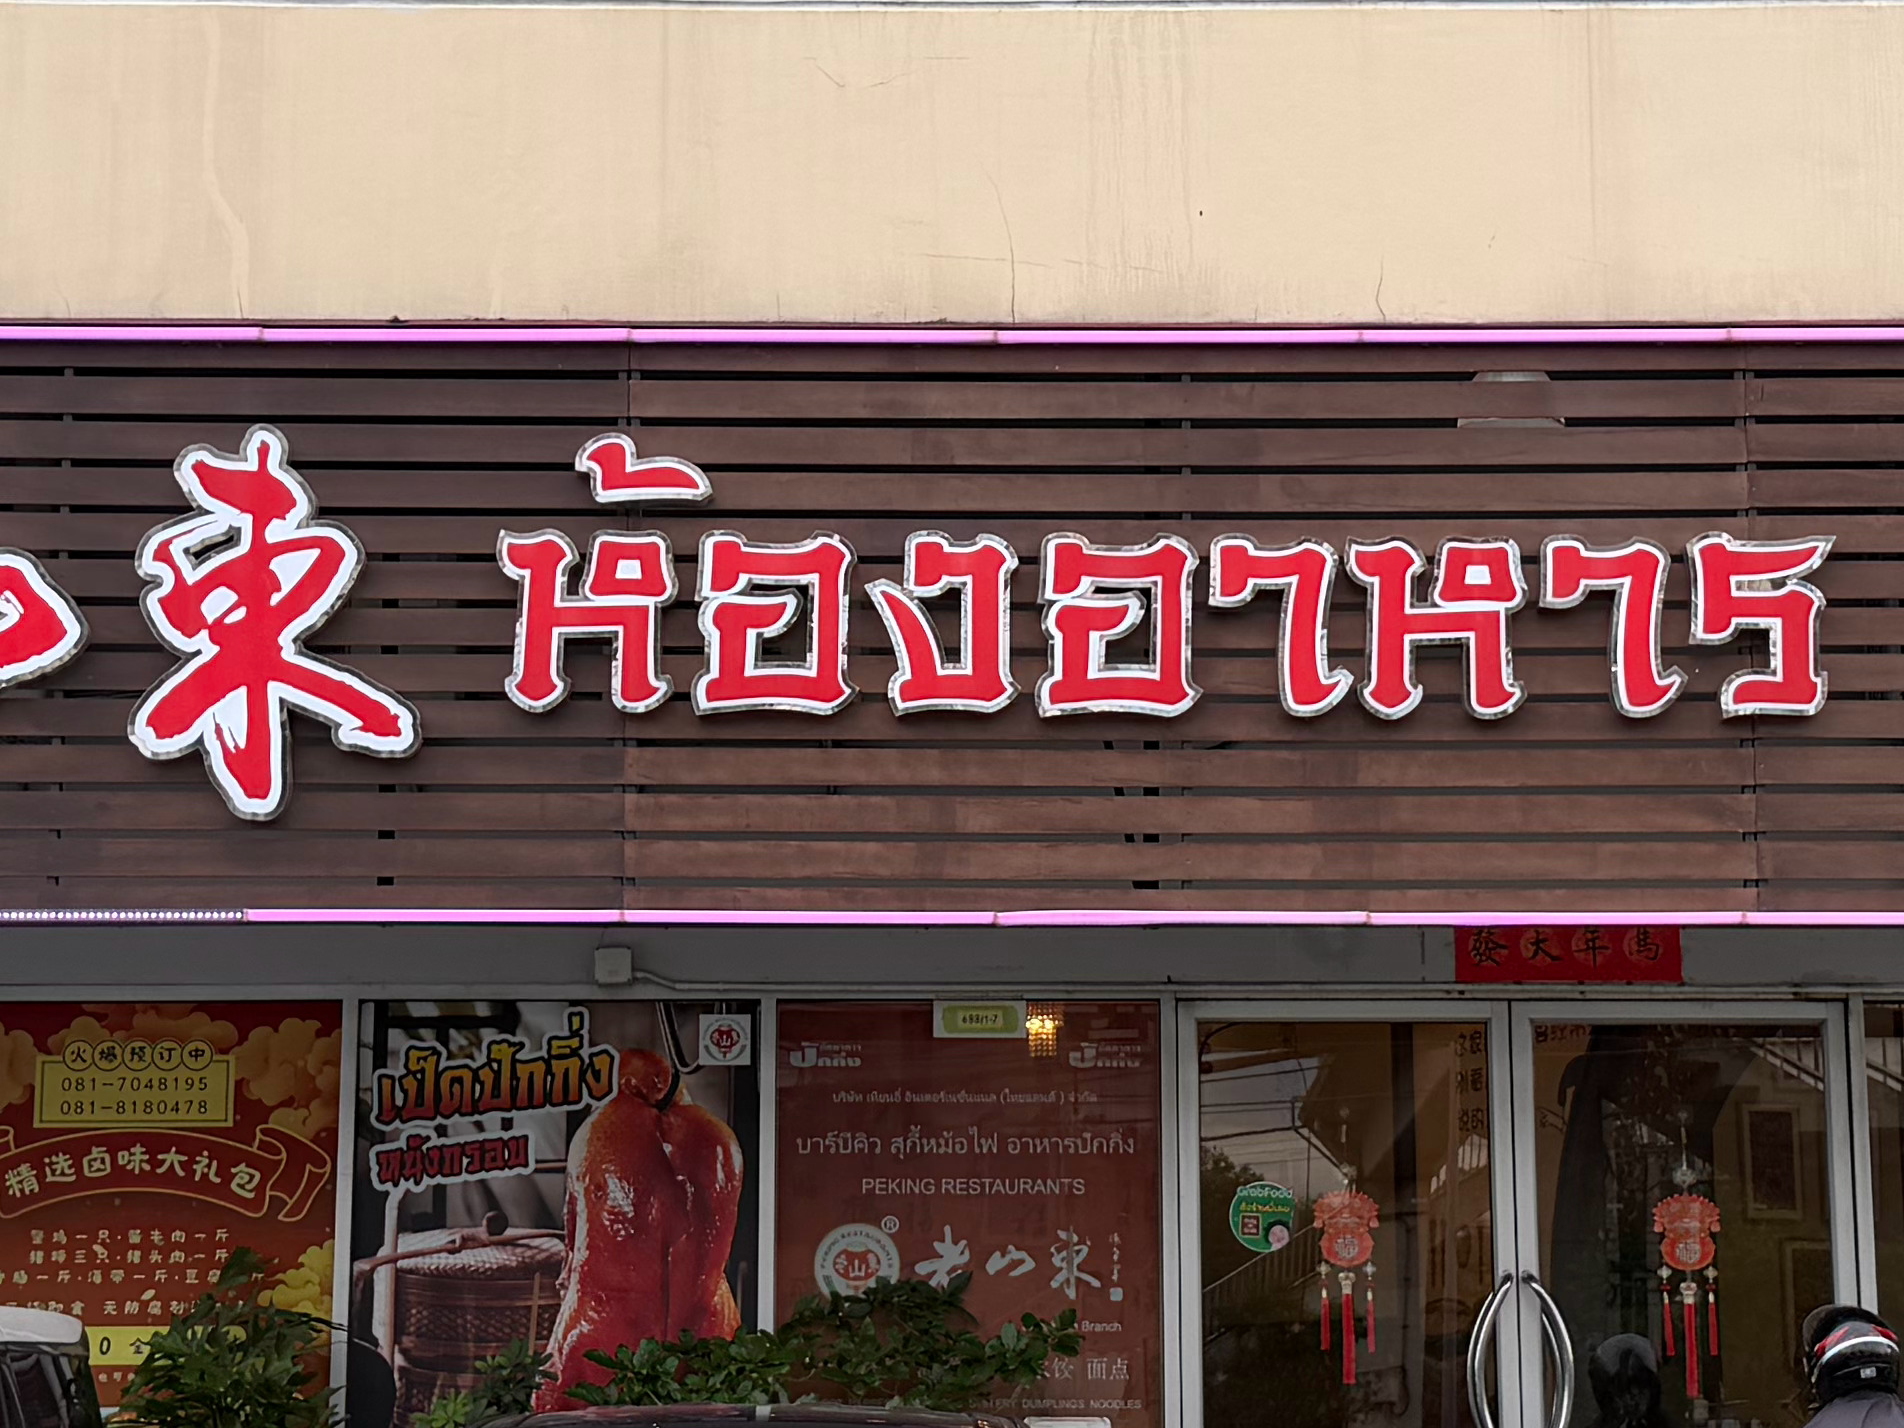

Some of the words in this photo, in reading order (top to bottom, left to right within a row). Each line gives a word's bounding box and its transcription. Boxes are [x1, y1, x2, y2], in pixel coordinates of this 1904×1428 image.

[499, 432, 1838, 720] ห้องอาหาร
[374, 1010, 616, 1125] เป็ดปักกิ่ง
[61, 1076, 209, 1092] 081-7048195
[59, 1099, 209, 1116] 081-8180478
[796, 1129, 882, 1155] บาร์บีคิว
[1007, 1128, 1135, 1155] อาหารปักกิ่ง
[4, 1142, 262, 1199] 精选卤味大礼包
[861, 1177, 936, 1195] PEKING
[941, 1177, 1086, 1195] RESTAURANTS
[1081, 1320, 1123, 1333] Branch
[1086, 1357, 1130, 1380] 面点
[1022, 1398, 1086, 1410] DUMPLINGS
[1089, 1398, 1143, 1410] NOODLES
